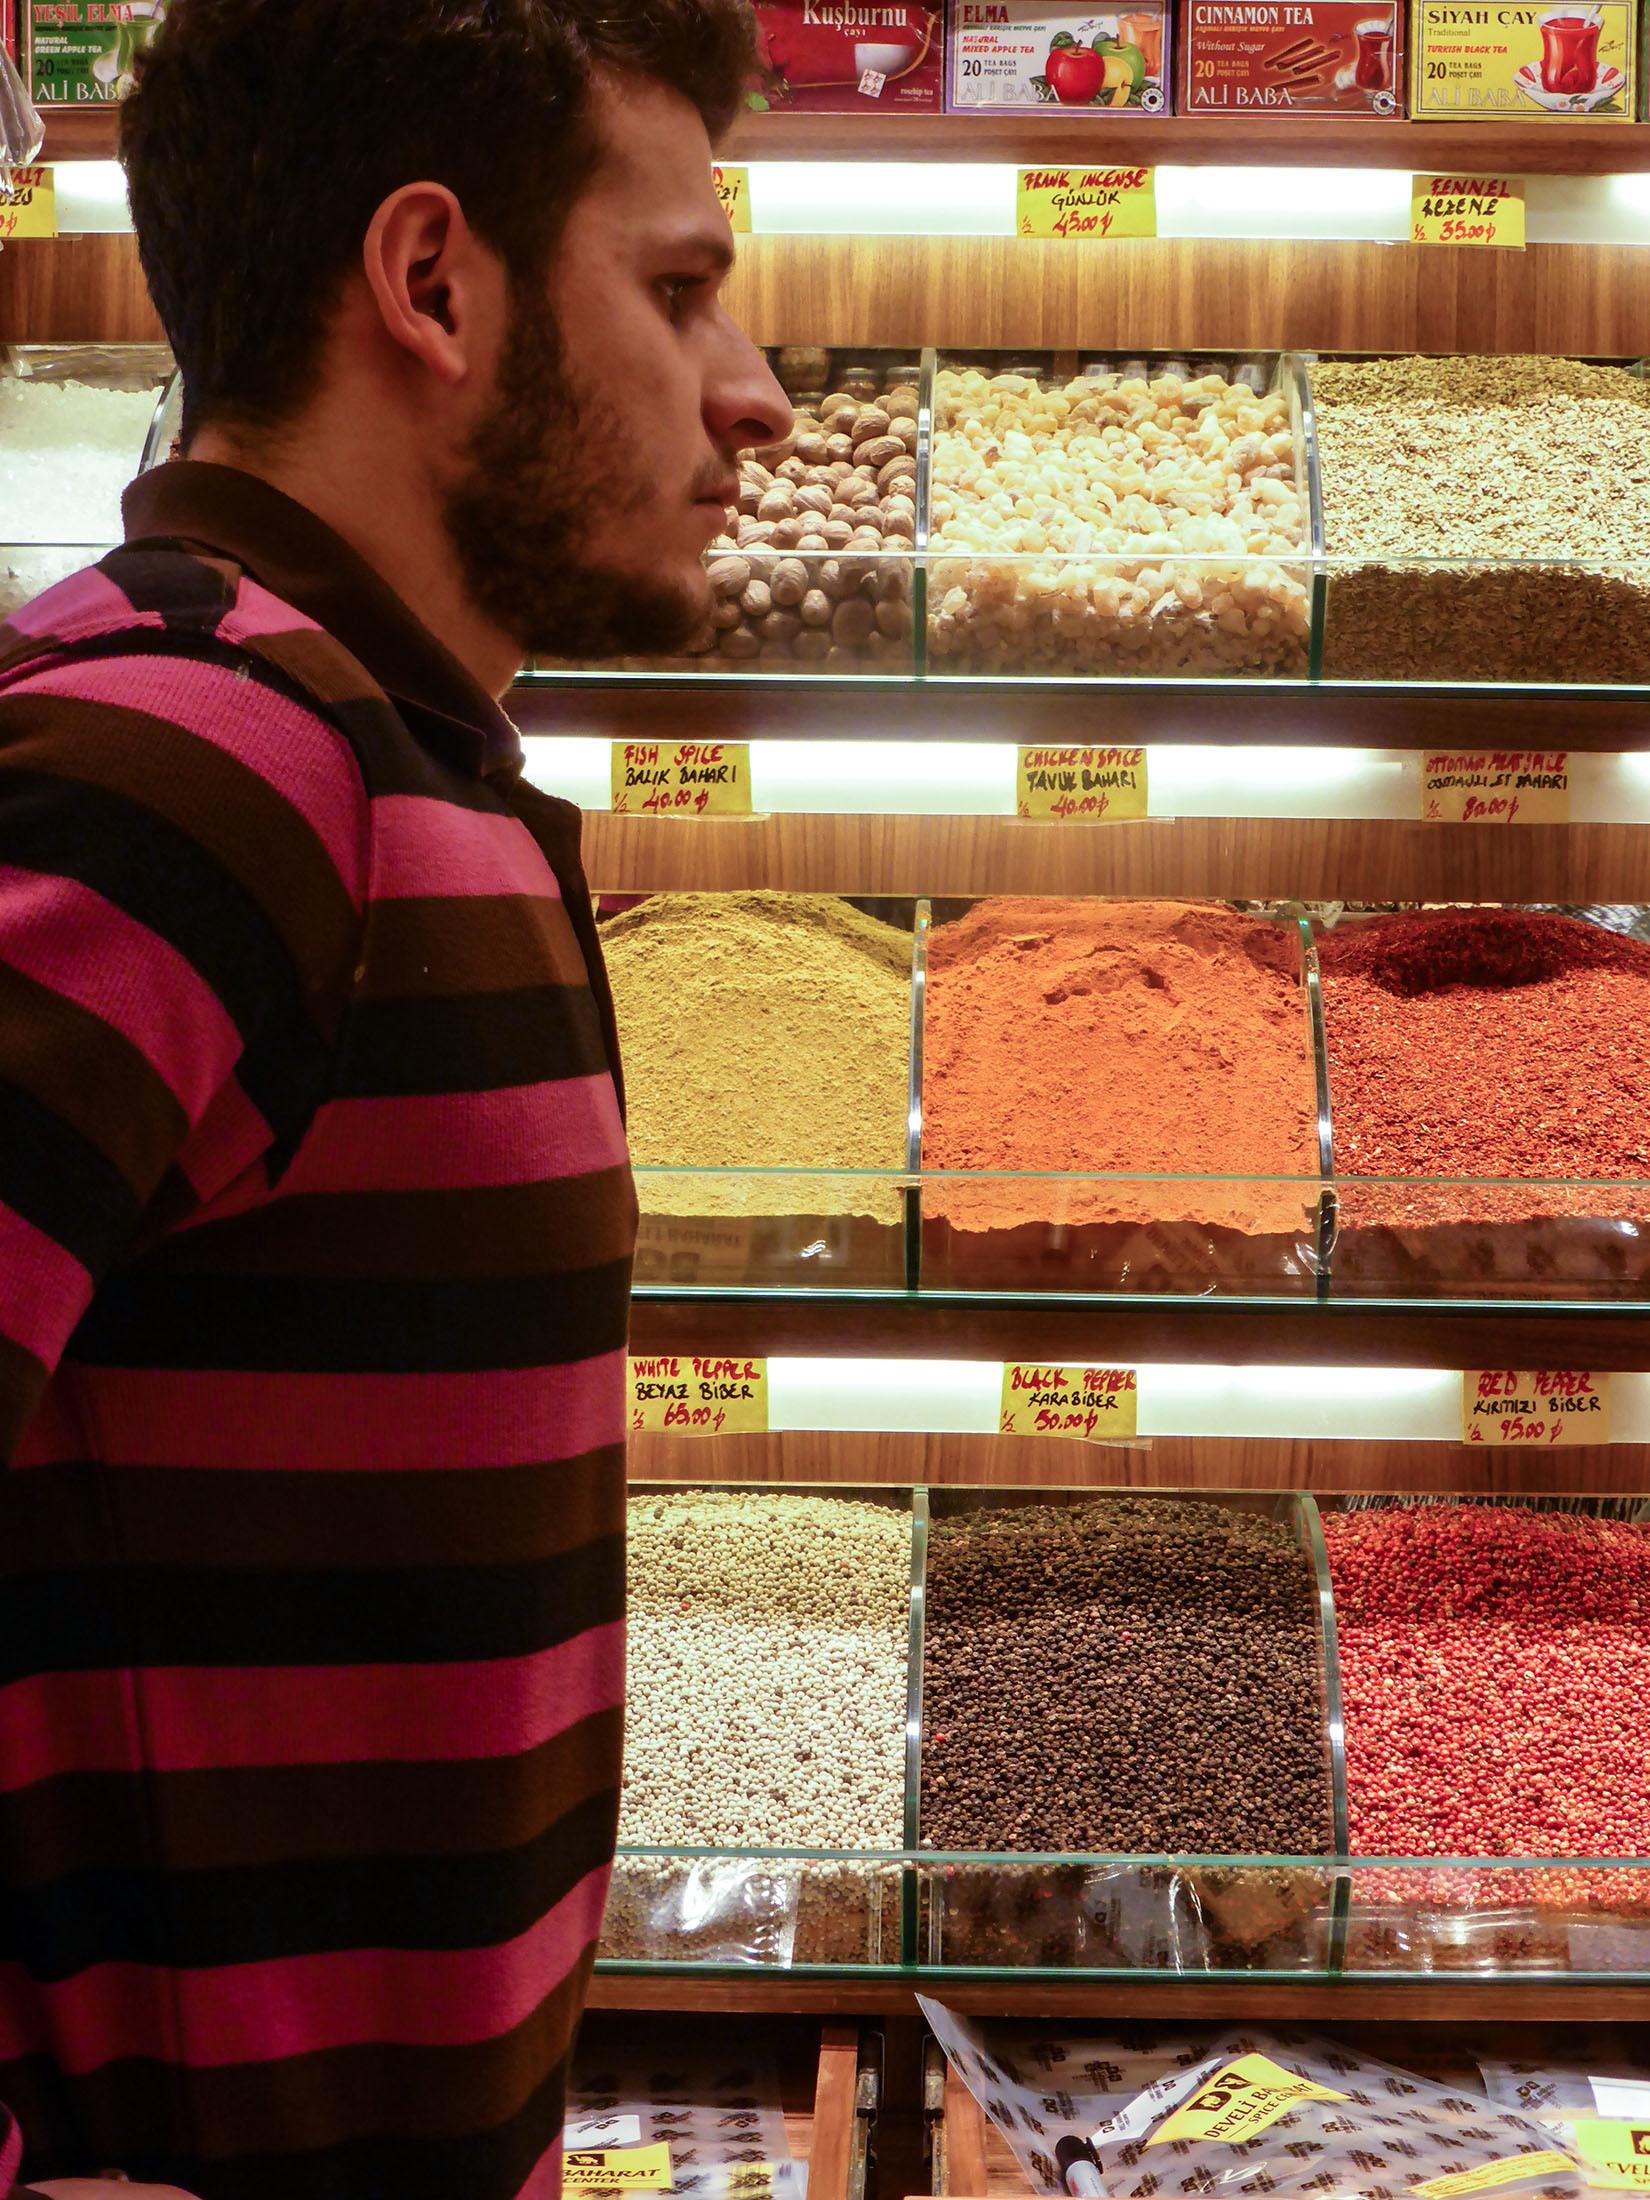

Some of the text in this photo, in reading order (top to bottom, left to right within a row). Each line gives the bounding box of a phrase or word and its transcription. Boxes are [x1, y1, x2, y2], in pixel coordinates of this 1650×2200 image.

[87, 4, 134, 22] ELMA
[803, 0, 907, 31] Kuşburnu
[963, 5, 1009, 23] ELMA
[1195, 6, 1314, 25] CINNAMON TEA
[1428, 5, 1537, 28] SİYAH ÇAY
[963, 35, 998, 43] NATURAL
[1428, 28, 1471, 36] Traditional
[1197, 40, 1265, 54] Without Sugar
[1427, 45, 1462, 53] TURKISH
[36, 59, 54, 76] 20
[962, 59, 981, 76] 20
[1195, 60, 1215, 78] 20
[1427, 62, 1446, 79] 20
[76, 82, 119, 100] BAB
[1003, 83, 1060, 102] BABA
[1194, 84, 1293, 105] ALİ BABA
[1468, 87, 1526, 106] BABA
[10, 167, 45, 187] ALT
[1023, 168, 1148, 192] FRANK INCENSE
[1430, 178, 1511, 198] FENNEL
[1051, 189, 1121, 211] GÜNLÜK
[624, 744, 659, 767] FISH
[1023, 748, 1143, 769] CHICKEN SPICE
[625, 765, 736, 786] BALIK BAHARI
[1026, 769, 1136, 792] TAVUK BAHARI
[1490, 773, 1512, 788] ET
[633, 1357, 761, 1380] WHITE PEPPER
[1011, 1366, 1137, 1393] BLACK PEPPER
[1477, 1370, 1595, 1397] RED PEPPER
[635, 1381, 754, 1400] BEYAZ BİBER
[1473, 1397, 1601, 1415] KIRMIZI BİBER
[1204, 2100, 1257, 2138] DEVELİ
[1248, 2101, 1279, 2124] SPICE
